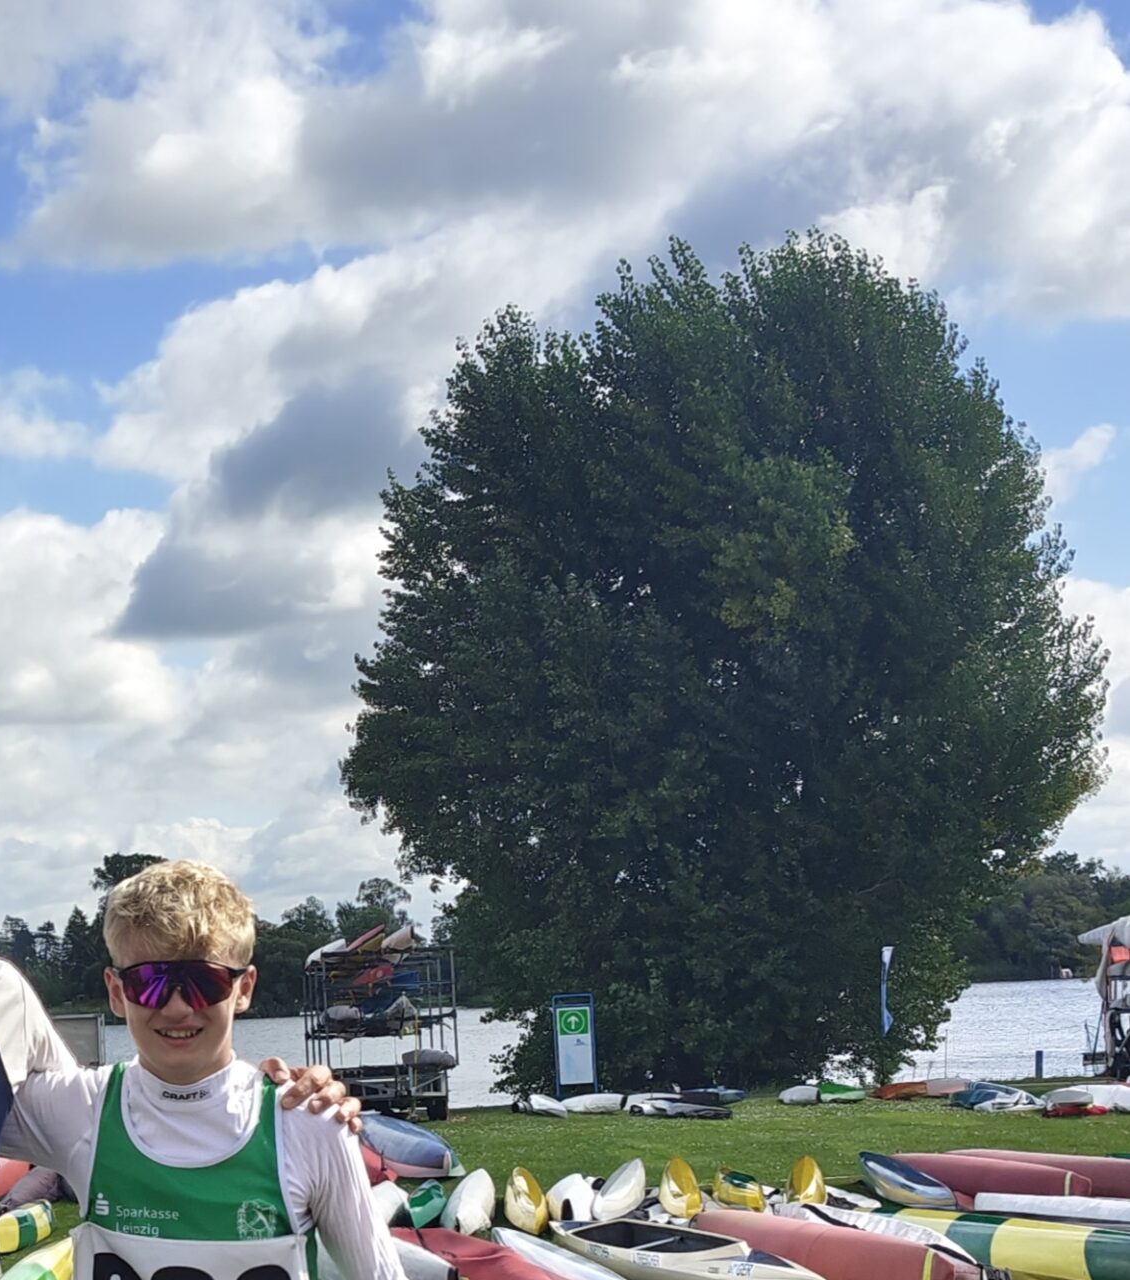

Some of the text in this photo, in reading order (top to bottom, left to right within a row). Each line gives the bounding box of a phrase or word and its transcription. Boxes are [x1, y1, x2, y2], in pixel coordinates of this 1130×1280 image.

[162, 1090, 198, 1101] CRAFT
[116, 1205, 179, 1220] Sparkasse
[116, 1221, 159, 1238] Leipzig
